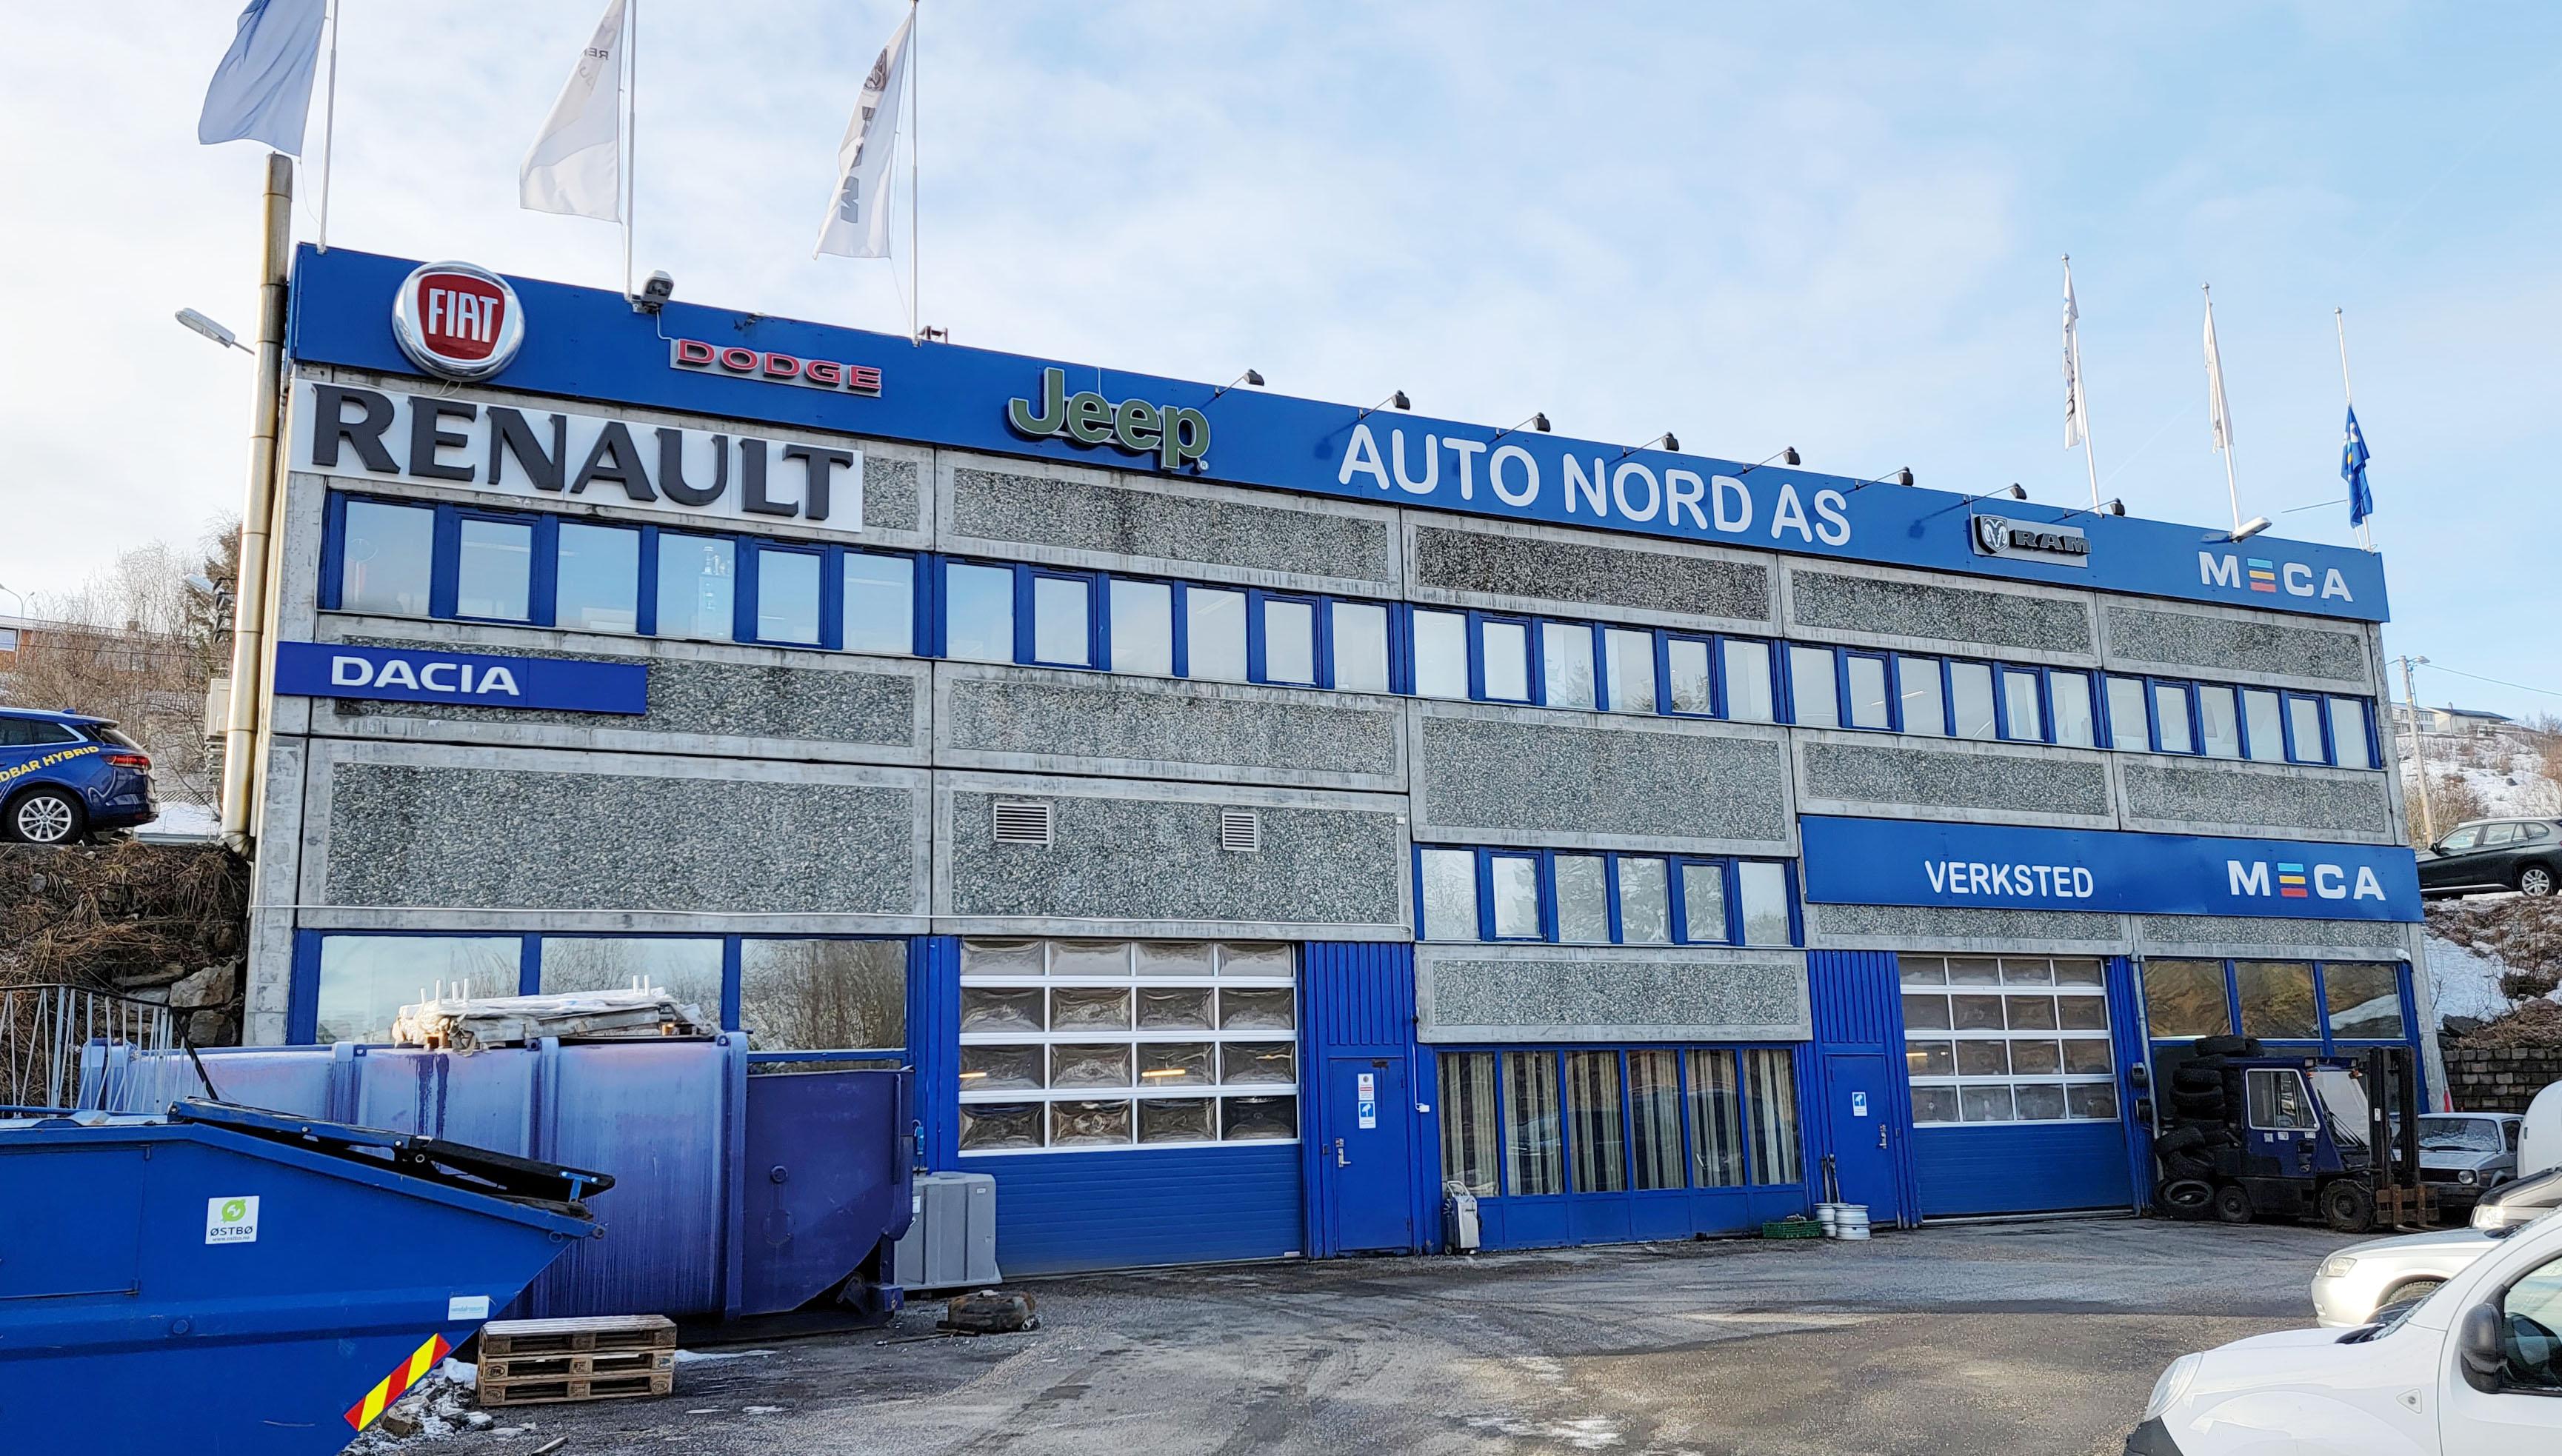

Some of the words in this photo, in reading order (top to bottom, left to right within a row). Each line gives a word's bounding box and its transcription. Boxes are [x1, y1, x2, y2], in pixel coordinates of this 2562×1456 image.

[428, 287, 501, 343] FIAT
[677, 339, 882, 392] DODGE
[1008, 367, 1211, 470] Jeep
[311, 383, 853, 521] RENAULT
[1338, 424, 1541, 507] AUTO
[1563, 453, 1754, 534] NORD
[1770, 484, 1852, 547] AS
[2015, 529, 2092, 554] RAM
[2198, 550, 2354, 603] MECA
[331, 656, 521, 696] DACIA
[0, 761, 41, 784] DBAR
[42, 746, 99, 767] HYBRID
[1925, 860, 2095, 898] VERKSTED
[2227, 860, 2386, 901] MECA
[210, 1226, 253, 1236] ØSTBØ
